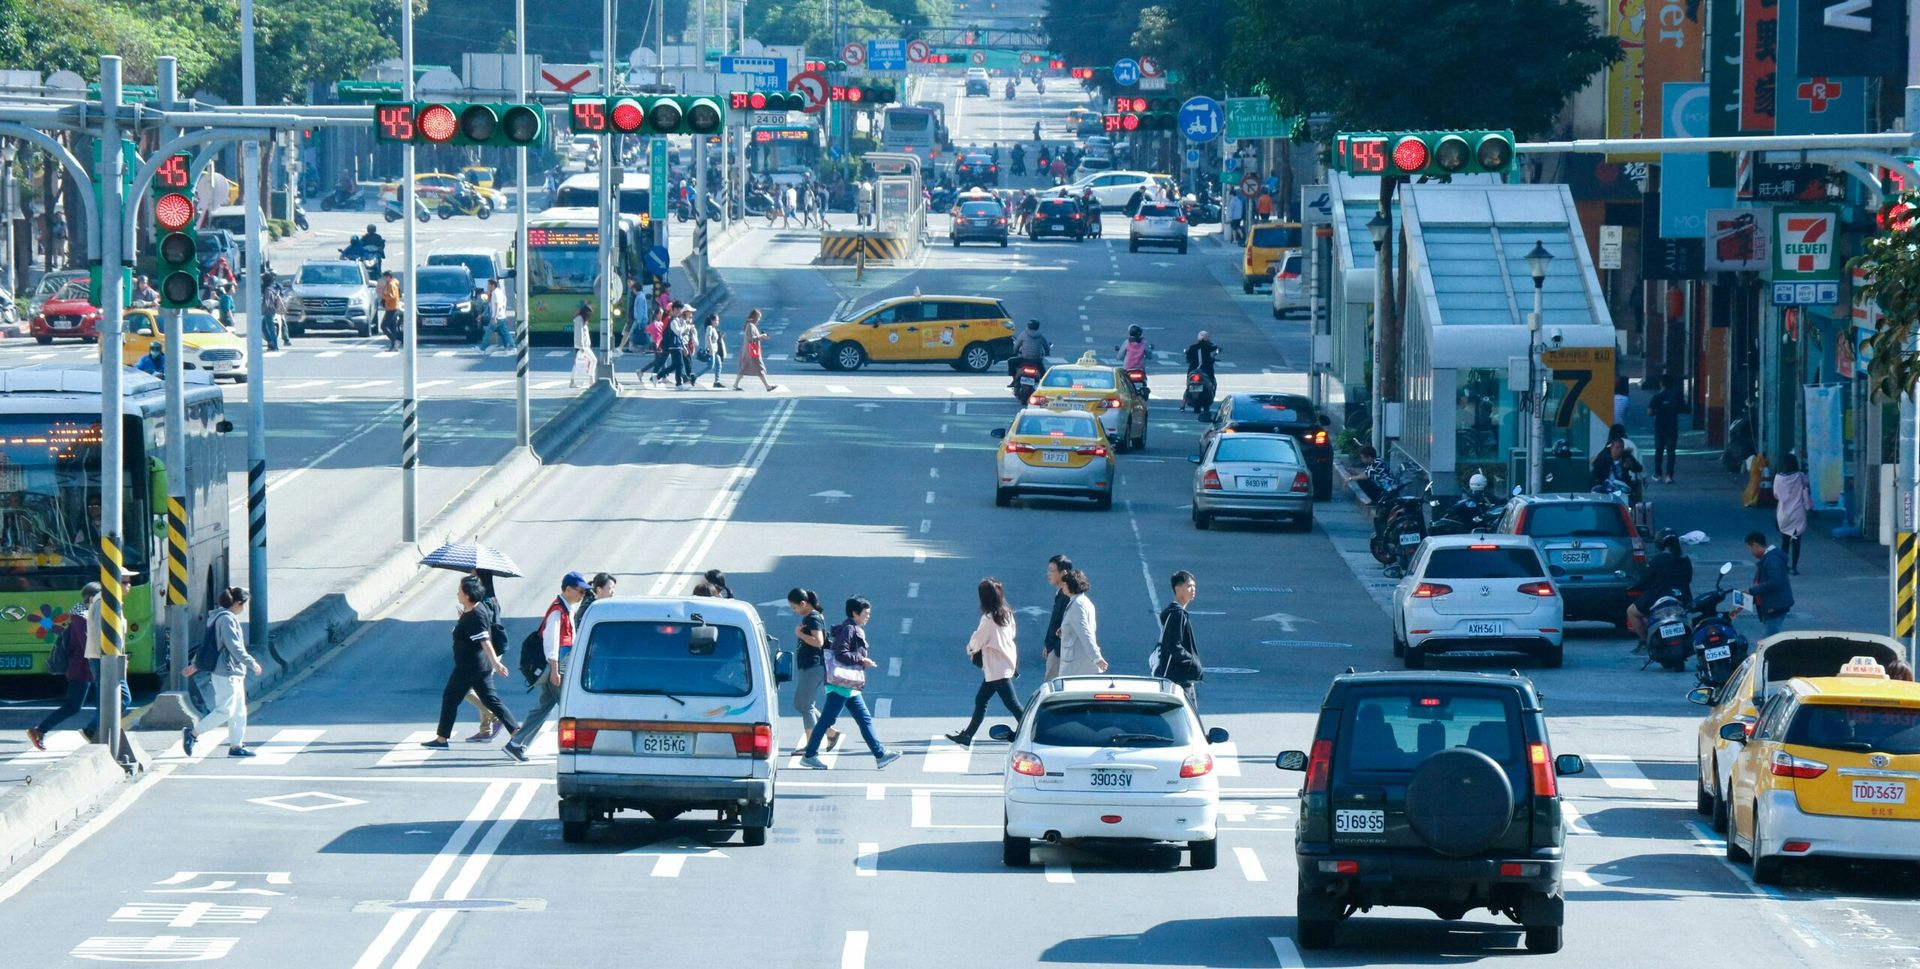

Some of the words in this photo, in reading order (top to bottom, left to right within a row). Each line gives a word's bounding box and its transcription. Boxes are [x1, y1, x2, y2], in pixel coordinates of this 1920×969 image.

[1659, 0, 1685, 48] er
[733, 94, 747, 108] 34
[832, 87, 846, 101] 34
[1117, 99, 1130, 112] 34
[381, 108, 413, 139] 45
[574, 104, 605, 130] 45
[1106, 117, 1120, 131] 34
[1353, 139, 1384, 172] 45
[156, 156, 188, 186] 45
[1787, 218, 1827, 271] 7
[1553, 370, 1592, 427] 7
[1853, 784, 1905, 800] TDD-3637
